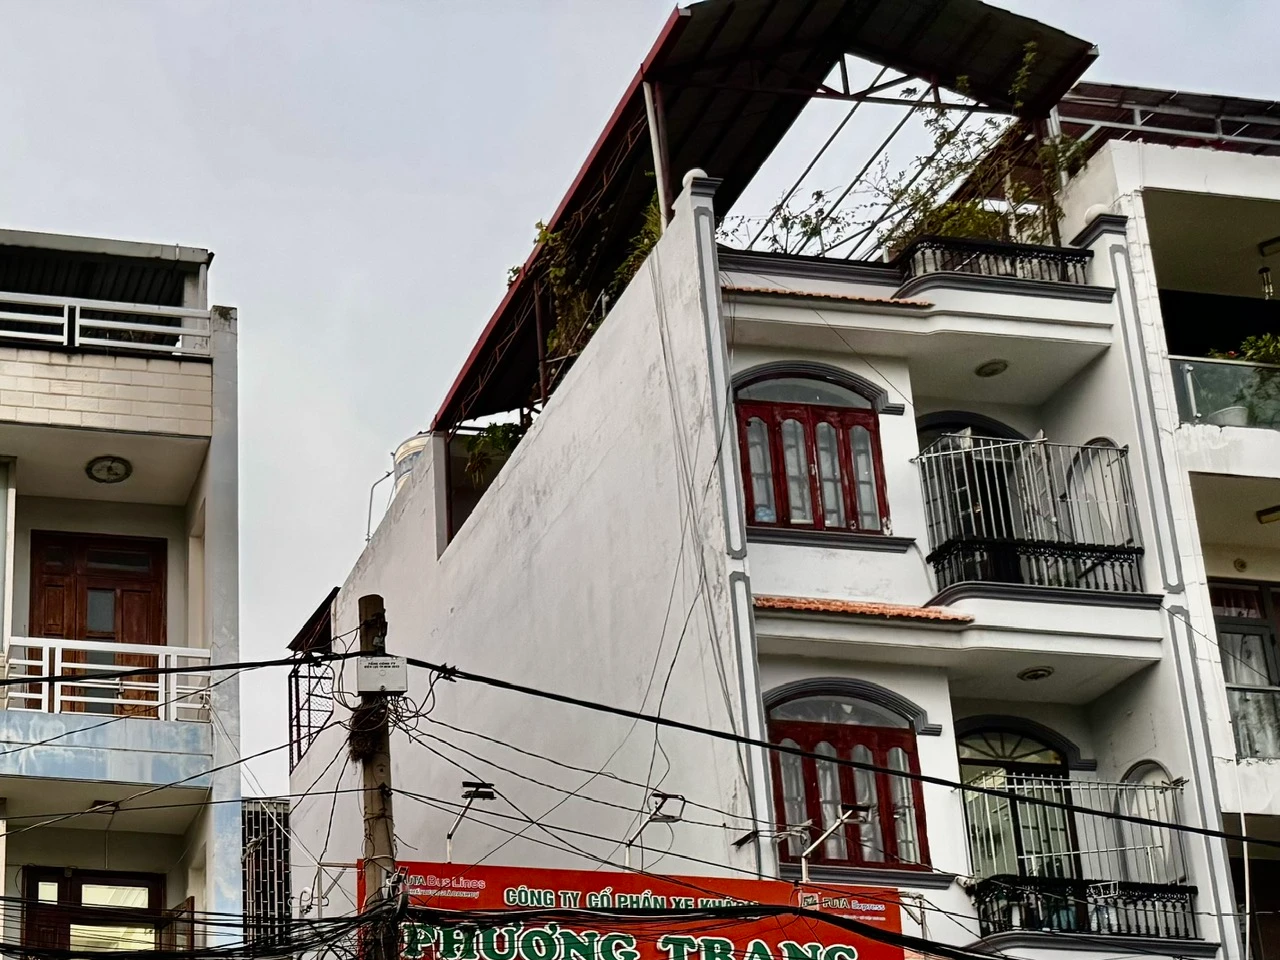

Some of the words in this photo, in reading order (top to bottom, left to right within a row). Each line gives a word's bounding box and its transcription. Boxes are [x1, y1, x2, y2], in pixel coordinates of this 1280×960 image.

[452, 876, 486, 890] Lines
[503, 885, 555, 907] CÔNG
[559, 889, 582, 909] TY
[587, 886, 613, 909] CỔ
[614, 890, 666, 910] PHẦN
